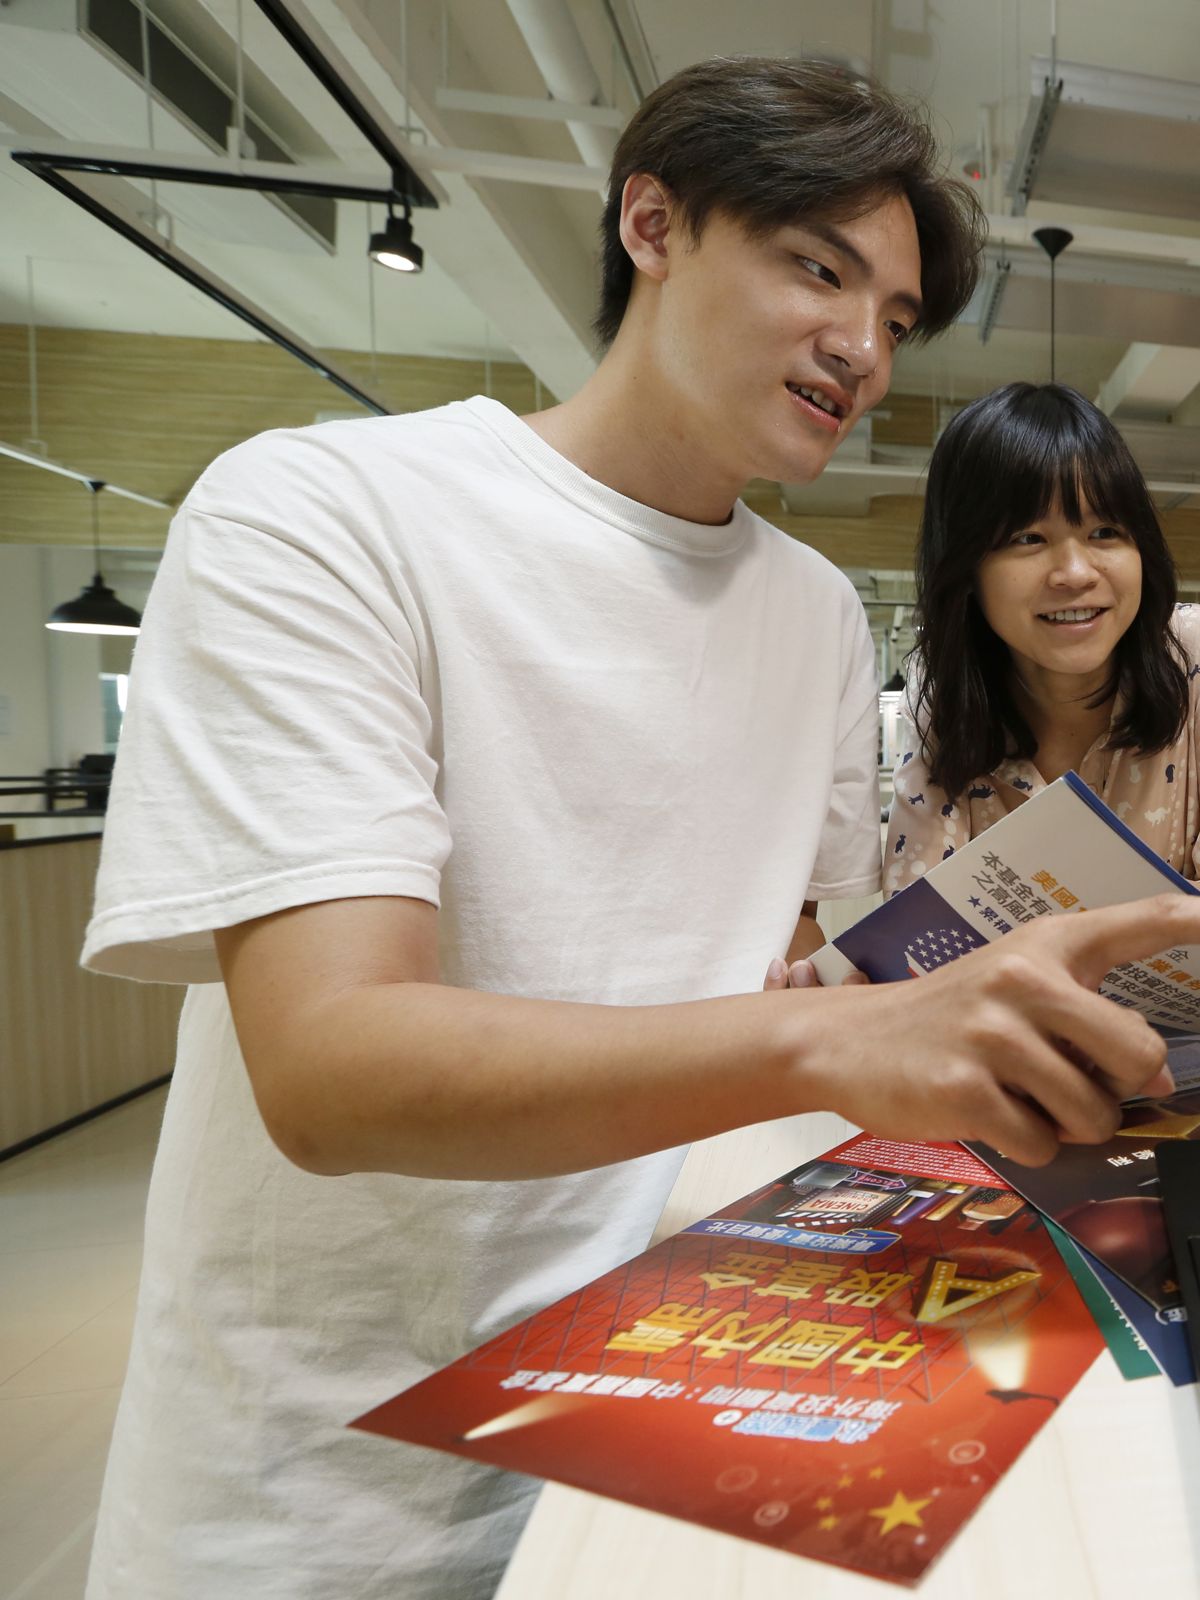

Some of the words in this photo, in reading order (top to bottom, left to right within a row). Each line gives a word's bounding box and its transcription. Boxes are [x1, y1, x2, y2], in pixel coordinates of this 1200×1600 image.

[981, 851, 1053, 916] 本基金有
[1030, 869, 1088, 912] 美國
[809, 1199, 868, 1212] CINEMA
[604, 1302, 926, 1375] 中國內需
